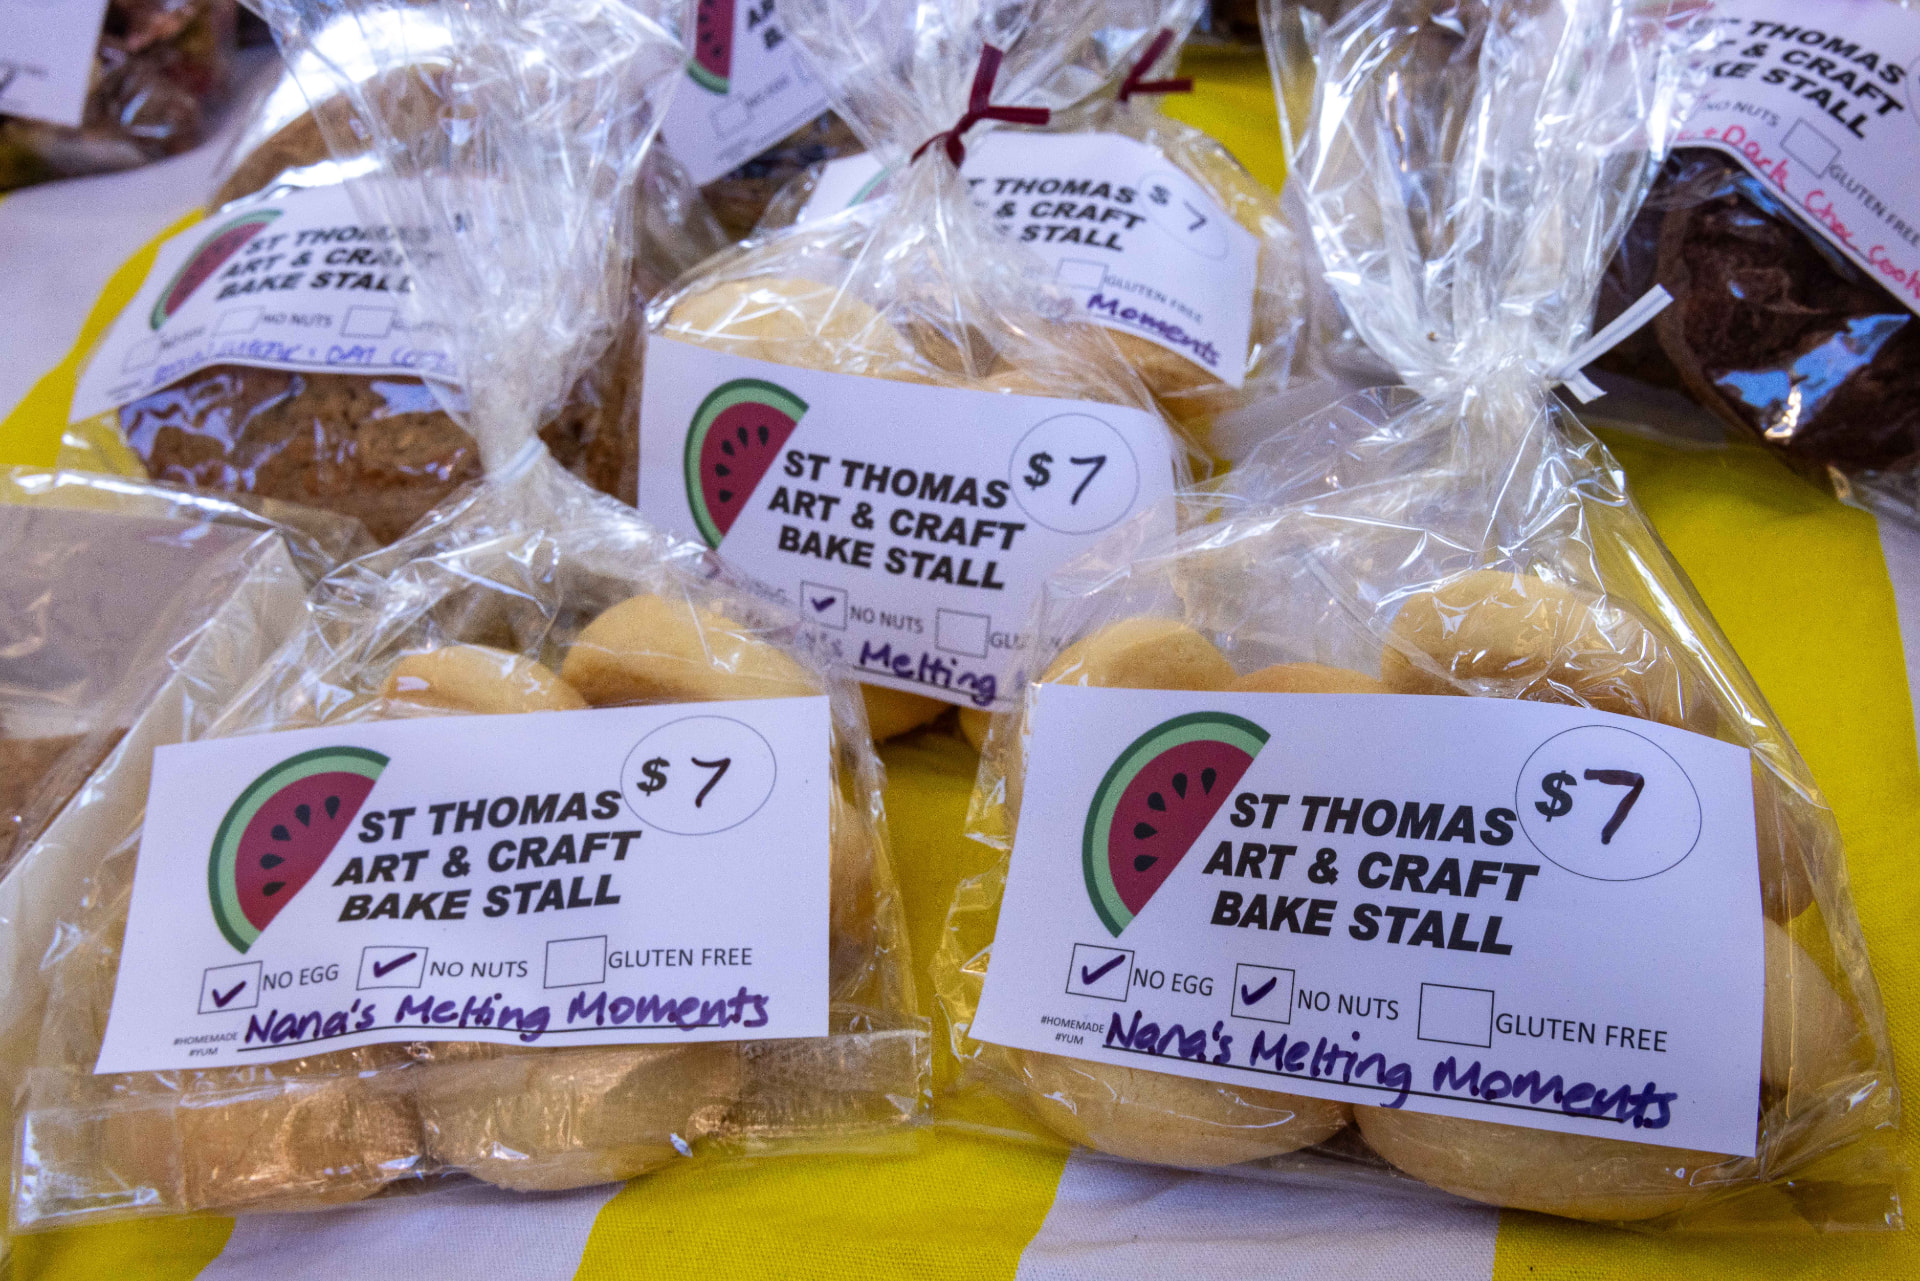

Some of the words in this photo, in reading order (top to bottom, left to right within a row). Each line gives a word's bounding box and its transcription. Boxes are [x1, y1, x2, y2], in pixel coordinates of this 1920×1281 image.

[1748, 20, 1906, 85] THOMAS
[1762, 67, 1870, 140] STALL
[1782, 49, 1905, 116] CRAFT
[1732, 100, 1781, 128] NUTS
[993, 177, 1138, 204] THOMAS
[1029, 201, 1147, 230] CRAFT
[1829, 164, 1887, 218] GLUTEN
[1019, 224, 1125, 252] STALL
[215, 271, 306, 302] BAKE
[217, 253, 287, 281] ART
[1086, 293, 1222, 368] Moments
[783, 449, 831, 481] ST
[840, 459, 1011, 510] THOMAS
[767, 485, 841, 522] ART
[850, 501, 875, 531] &
[888, 508, 1026, 551] CRAFT
[777, 525, 876, 569] BAKE
[884, 546, 1006, 591] STALL
[850, 605, 876, 624] NO
[879, 610, 925, 635] NUTS
[858, 640, 998, 708] Melting
[357, 806, 416, 844] ST
[427, 789, 623, 837] THOMAS
[1229, 791, 1291, 830] ST
[1299, 794, 1518, 847] THOMAS
[331, 849, 430, 887] ART
[440, 845, 472, 879] &
[486, 829, 643, 873] CRAFT
[1202, 840, 1297, 881] ART
[1307, 846, 1340, 886] &
[1357, 850, 1541, 903] CRAFT
[337, 888, 473, 923] BAKE
[481, 873, 622, 919] STALL
[1210, 890, 1338, 937] BAKE
[1347, 902, 1515, 956] STALL
[262, 971, 294, 992] NO
[299, 963, 341, 987] EGG
[429, 961, 464, 978] NO
[470, 960, 529, 979] NUTS
[607, 948, 694, 970] GLUTEN
[701, 947, 753, 967] FREE
[1133, 967, 1166, 990] NO
[1171, 972, 1215, 998] EGG
[244, 998, 377, 1045] Nana's
[394, 992, 551, 1043] Melting
[566, 985, 769, 1033] Moments
[1040, 1014, 1105, 1036] #HOMEMADE
[1297, 988, 1331, 1013] NO
[1337, 994, 1400, 1021] NUTS
[173, 1031, 240, 1047] #HOMEMADE
[1055, 1032, 1085, 1047] #YUM
[1494, 1011, 1596, 1045] GLUTEN
[1605, 1024, 1668, 1053] FREE
[1105, 1010, 1233, 1066] Nana's
[1250, 1029, 1413, 1109] Melting
[1432, 1056, 1679, 1130] Moments
